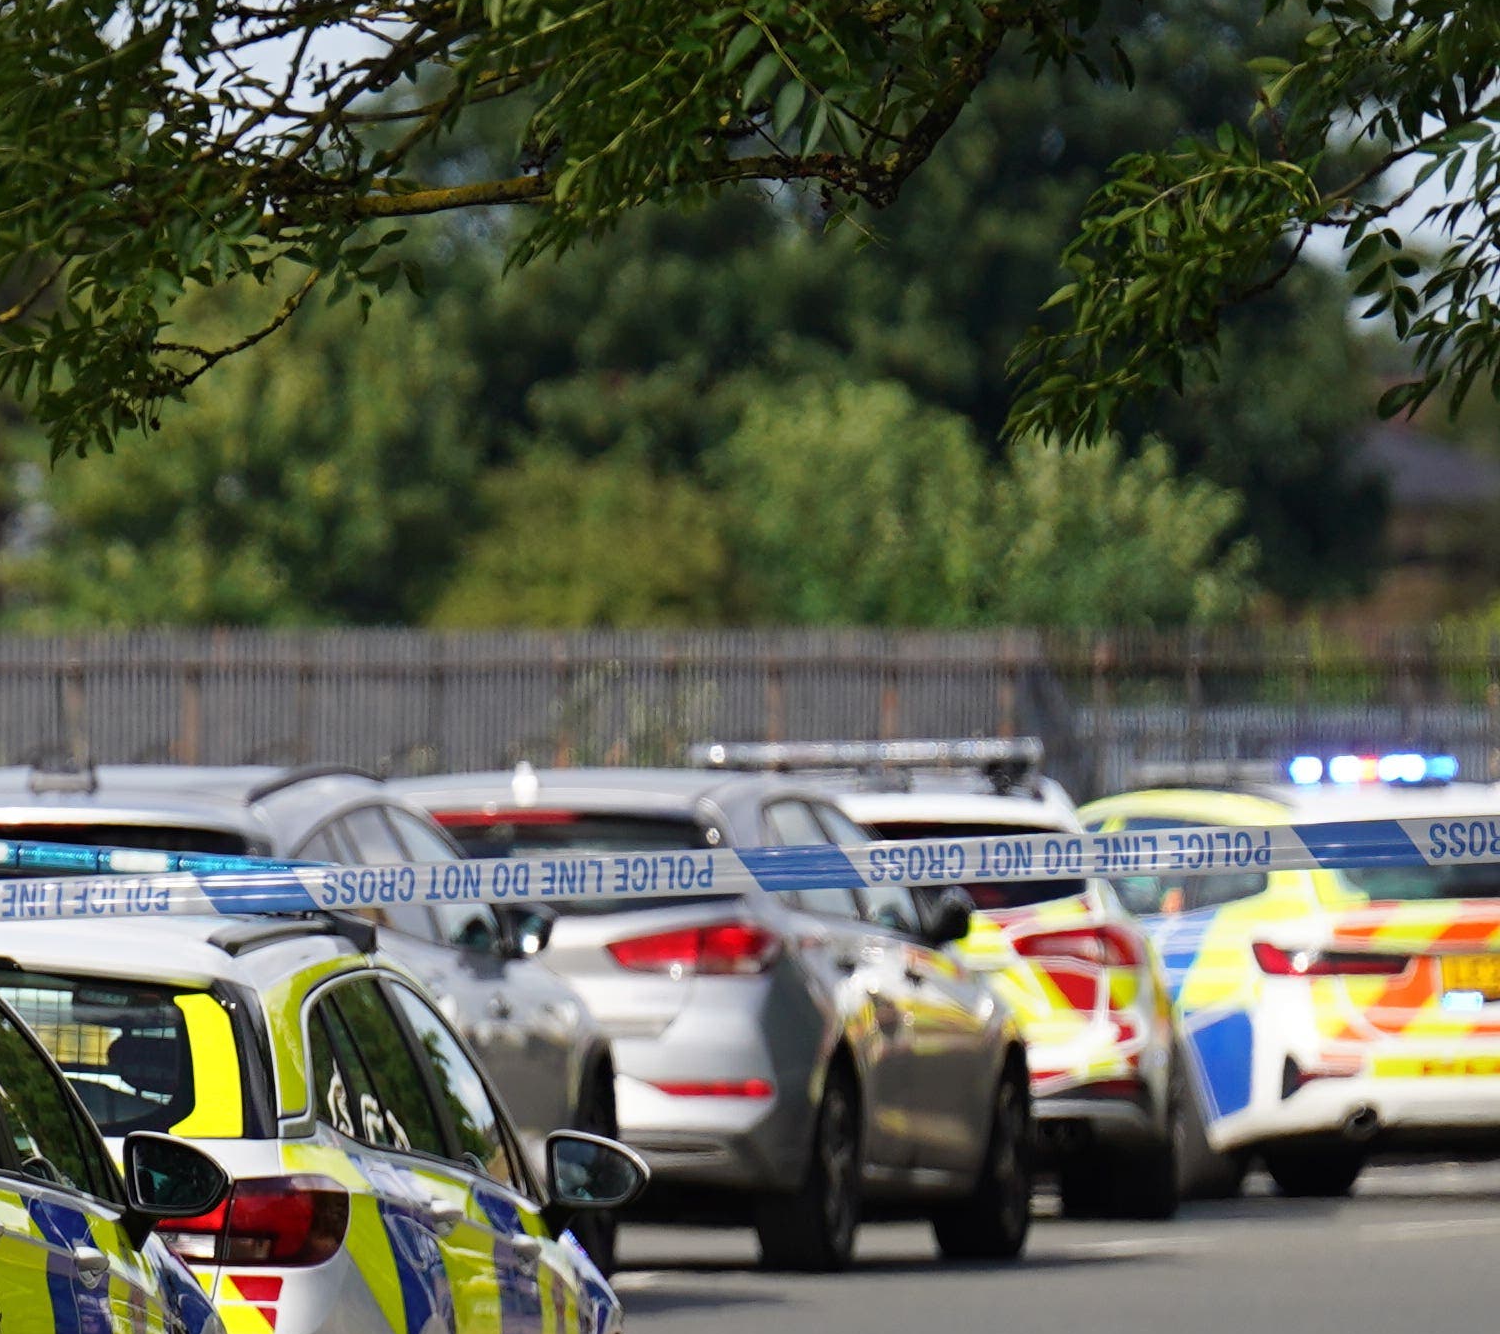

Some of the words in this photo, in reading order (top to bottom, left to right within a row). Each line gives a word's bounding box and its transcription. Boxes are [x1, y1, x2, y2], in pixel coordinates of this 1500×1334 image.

[1044, 839, 1083, 876] DO
[1093, 835, 1158, 873] LINE
[1168, 831, 1272, 870] POLICE
[1429, 821, 1500, 859] ROSS
[541, 859, 603, 895] LINE
[613, 854, 714, 893] POLICE
[869, 843, 965, 882] CROSS
[976, 841, 1033, 878] NOT
[73, 879, 170, 916] POLICE
[322, 866, 416, 906] CROSS
[426, 864, 482, 900] NOT
[492, 862, 530, 897] DO
[2, 883, 62, 918] LINE
